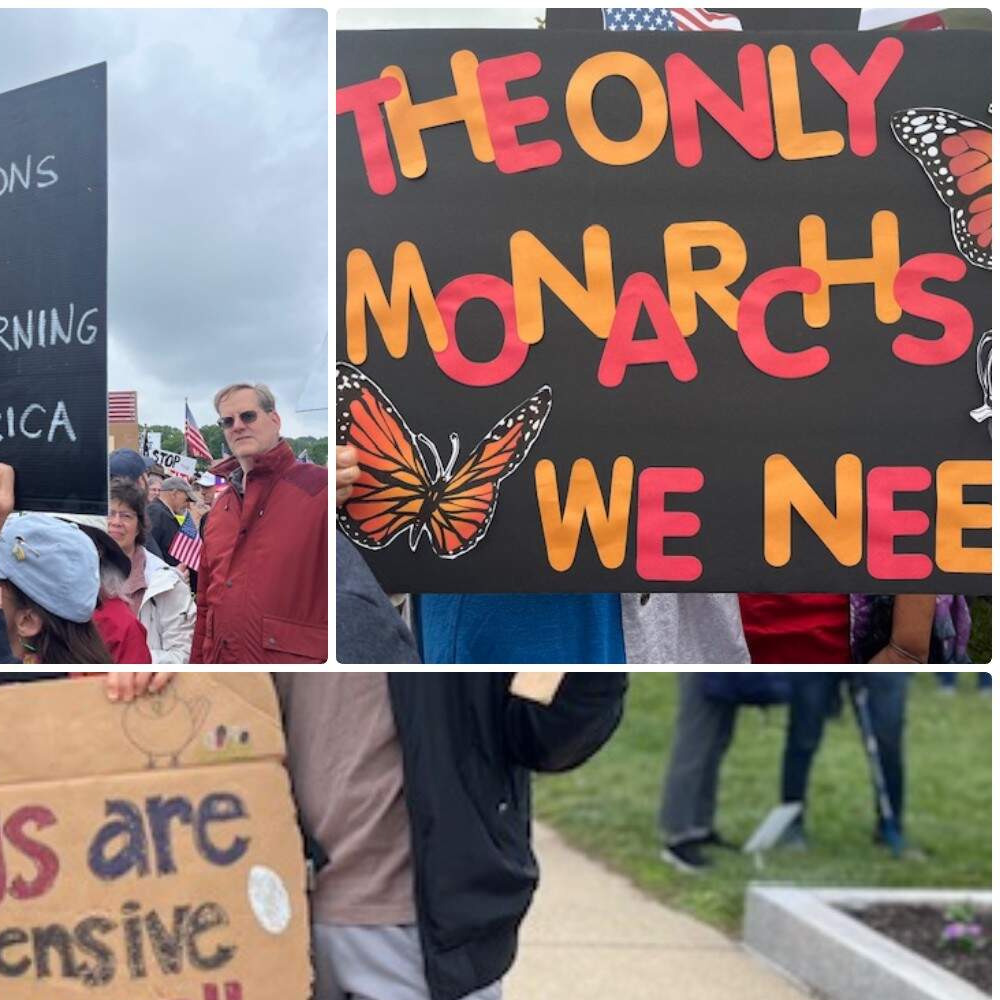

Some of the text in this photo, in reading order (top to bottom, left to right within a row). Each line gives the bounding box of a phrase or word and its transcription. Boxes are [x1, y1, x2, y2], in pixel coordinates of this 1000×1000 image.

[336, 37, 904, 196] THE ONLY
[346, 210, 974, 388] MONARCHS
[152, 449, 181, 468] STOP
[534, 455, 705, 582] WE
[86, 791, 251, 880] are
